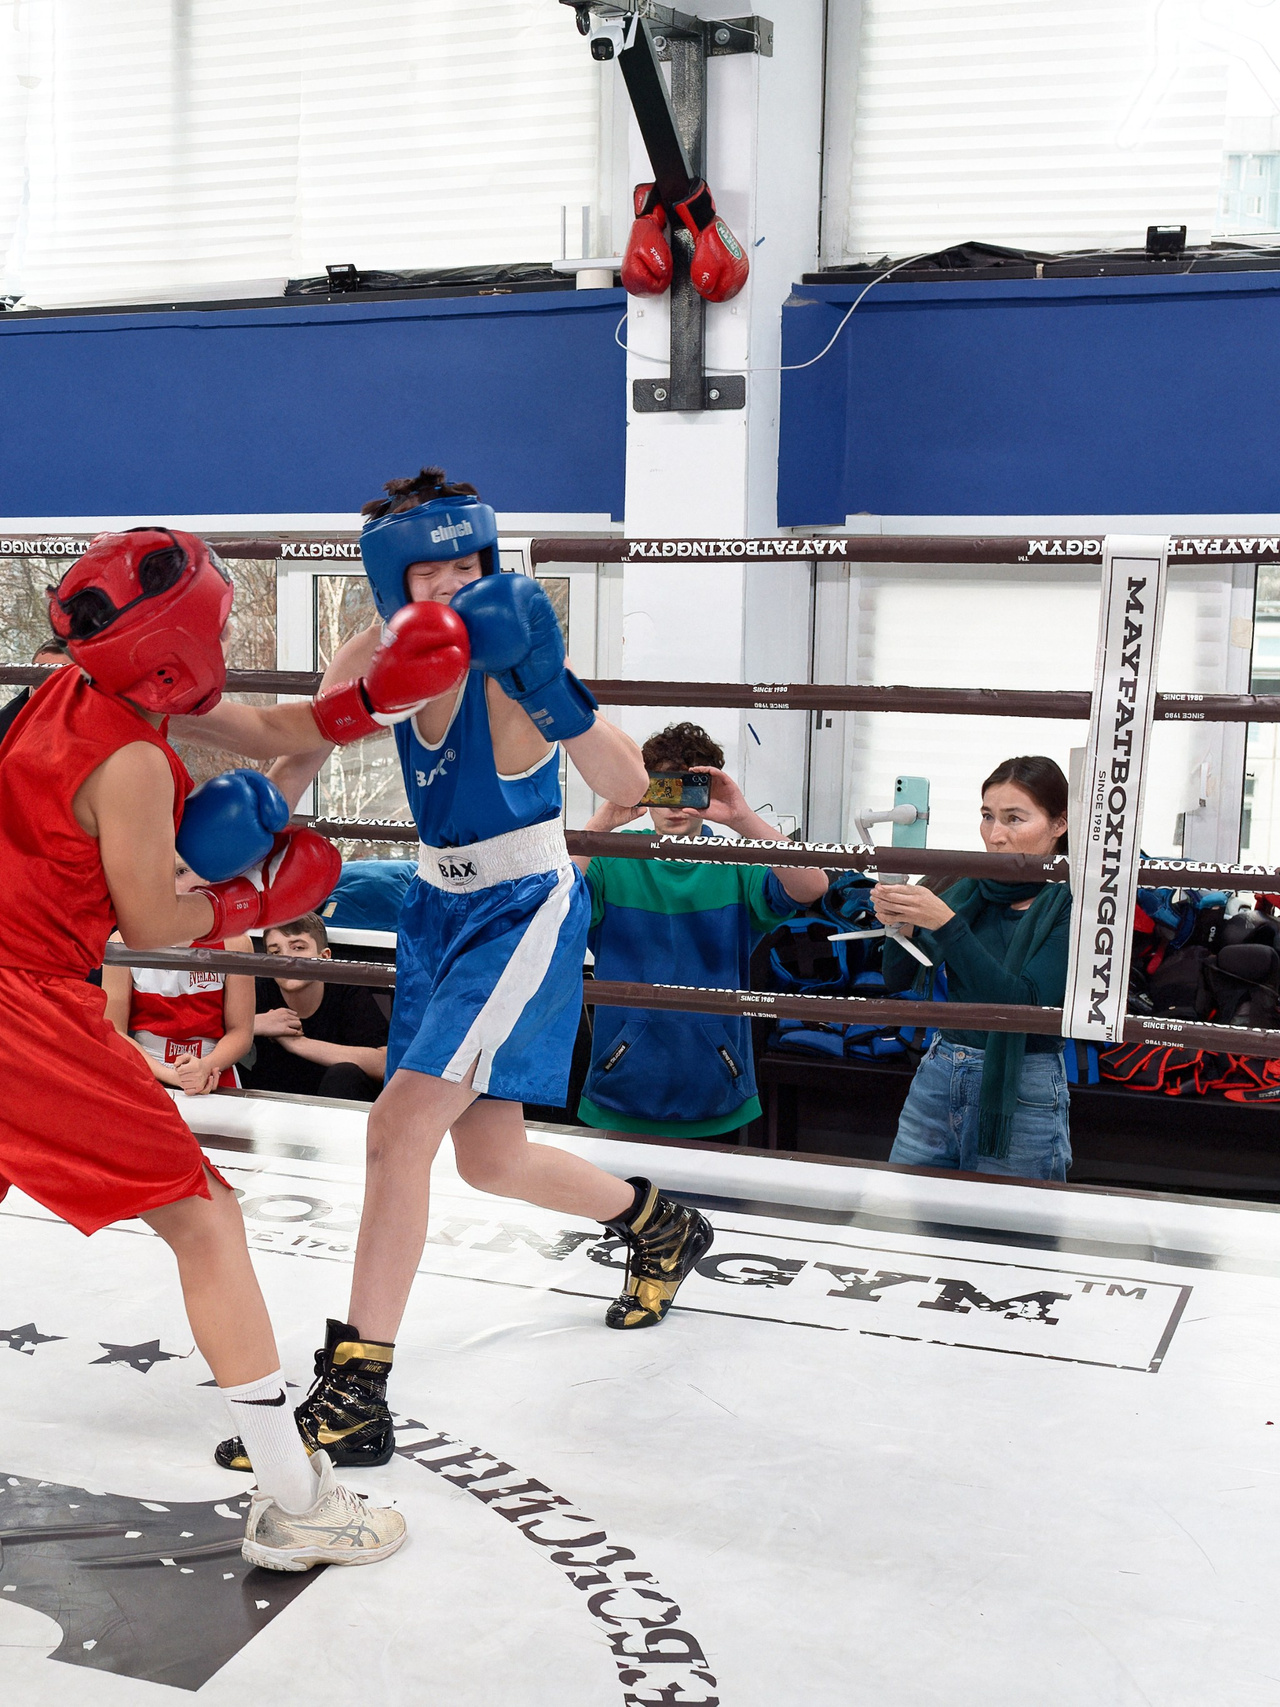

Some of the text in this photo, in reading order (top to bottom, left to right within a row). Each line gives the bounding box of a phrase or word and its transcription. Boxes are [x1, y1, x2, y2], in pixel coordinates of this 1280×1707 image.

[431, 520, 473, 543] clinch
[629, 540, 848, 557] MAYFATBOXINGGYM
[1087, 576, 1147, 1025] MAYFATBOXINGGYM
[1092, 771, 1107, 841] SINCE 1980
[438, 862, 477, 879] BAX
[1143, 1021, 1164, 1030] SINCE
[1164, 1023, 1183, 1031] 1980
[1074, 1279, 1147, 1300] TM
